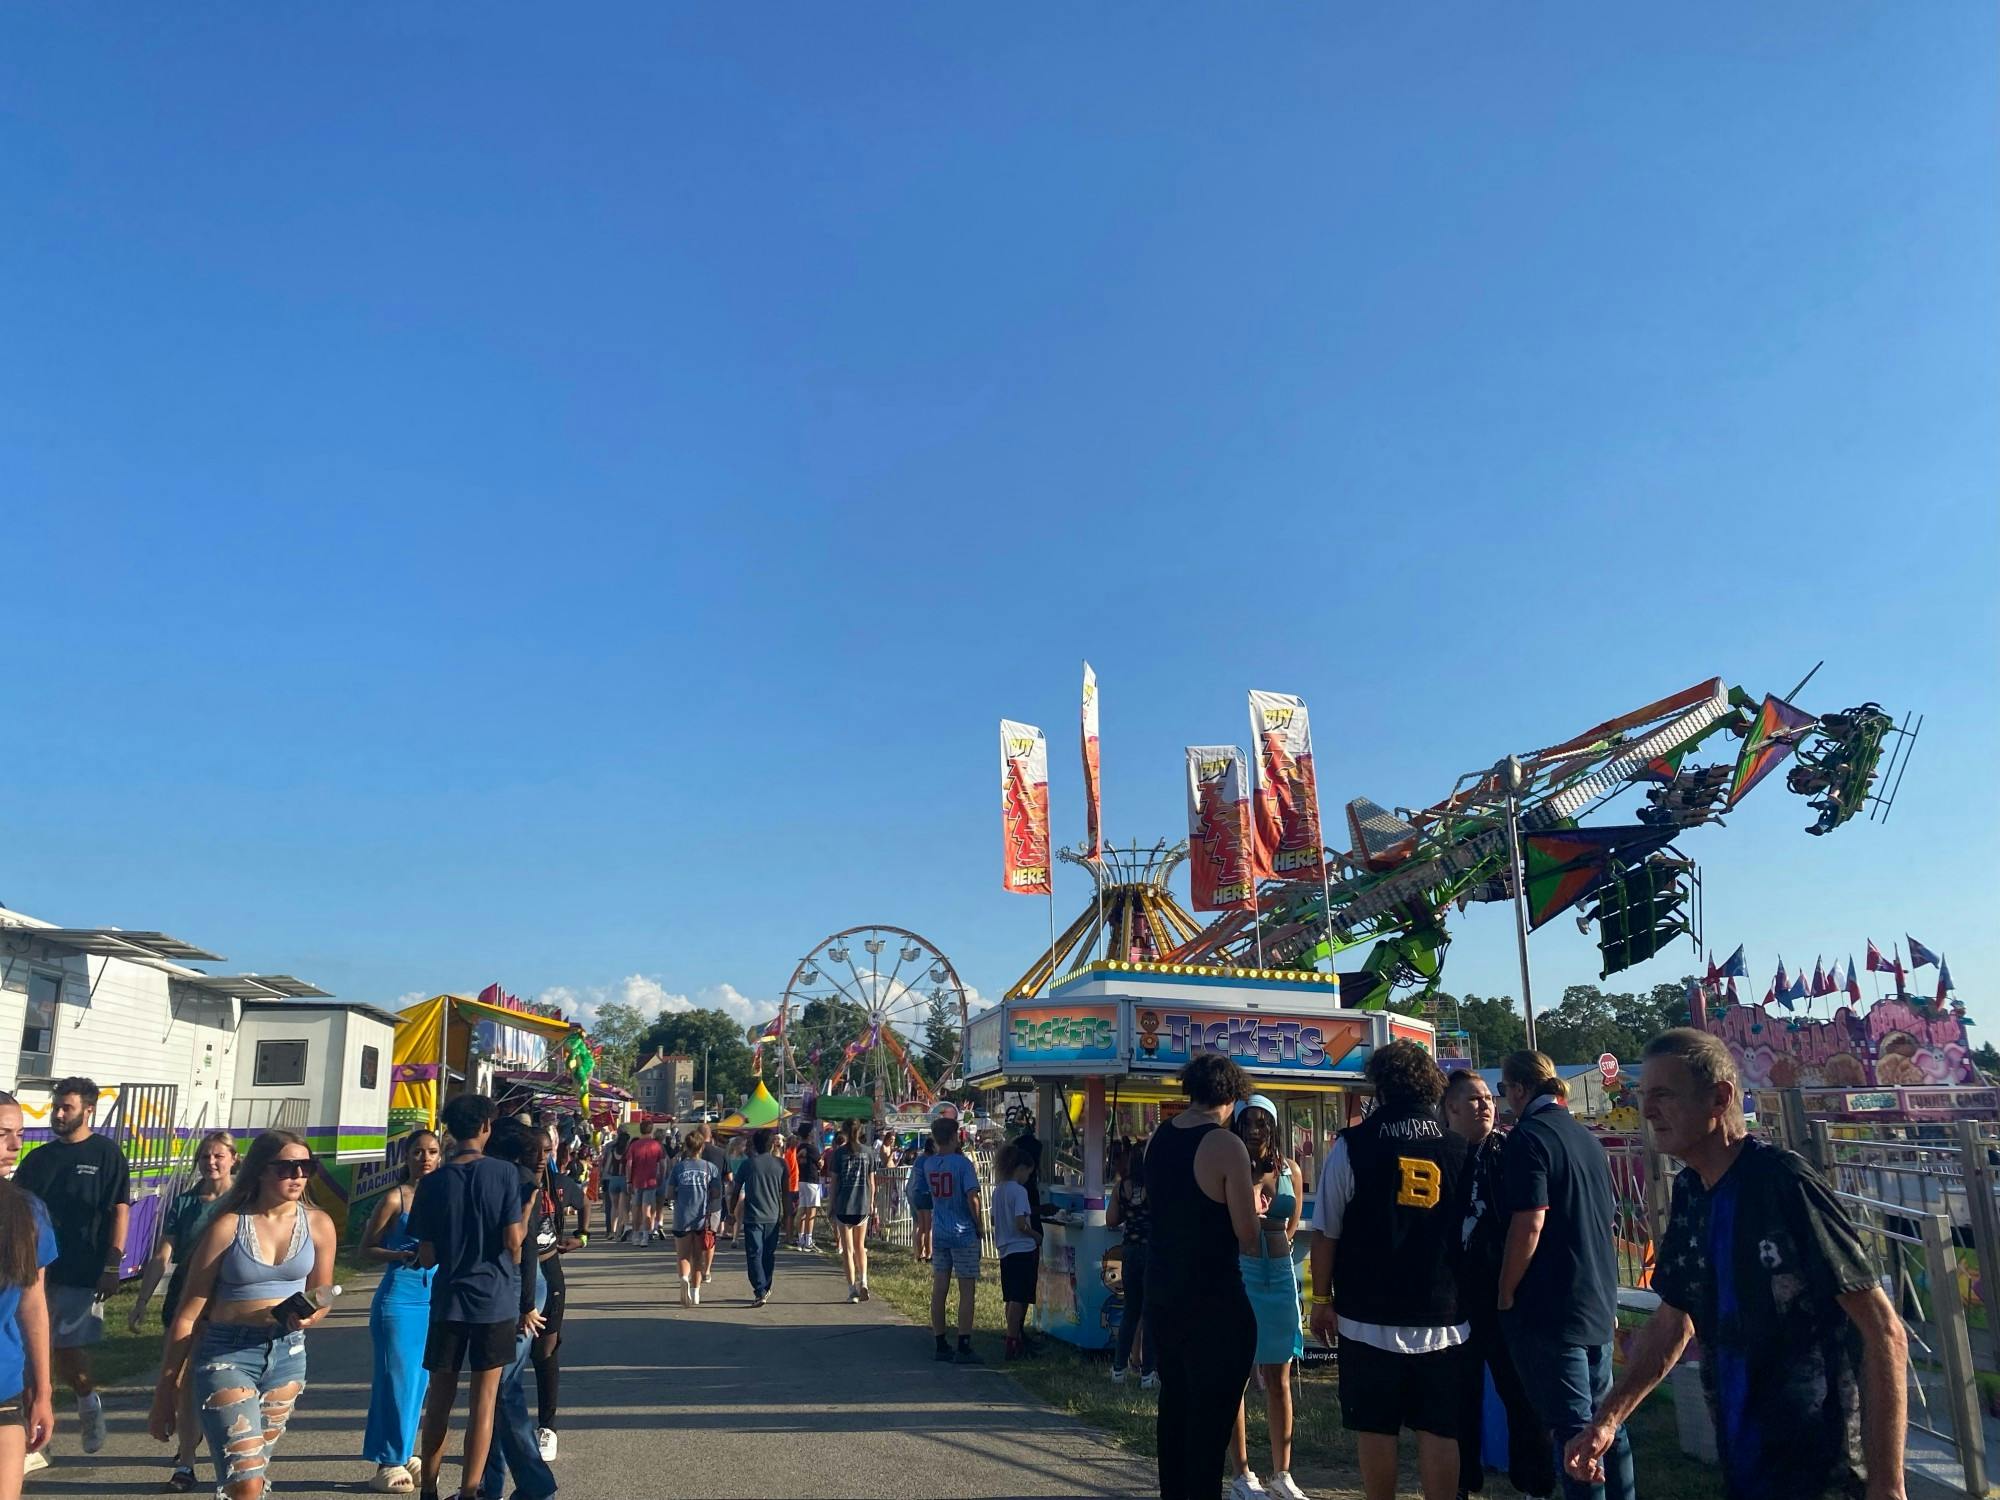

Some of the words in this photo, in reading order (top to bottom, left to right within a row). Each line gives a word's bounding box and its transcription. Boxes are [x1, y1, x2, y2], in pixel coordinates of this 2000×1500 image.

[1262, 708, 1294, 732] BUY
[1199, 758, 1232, 782] BUY
[1273, 847, 1319, 873] HERE
[1011, 867, 1048, 887] HERE
[1212, 883, 1251, 906] HERE
[1014, 1015, 1113, 1053] TICKETS
[1164, 1014, 1326, 1067] TICKETS
[1601, 1060, 1616, 1071] STOP
[356, 1169, 402, 1196] MACHIN
[929, 1172, 953, 1198] 50
[1397, 1156, 1441, 1209] B
